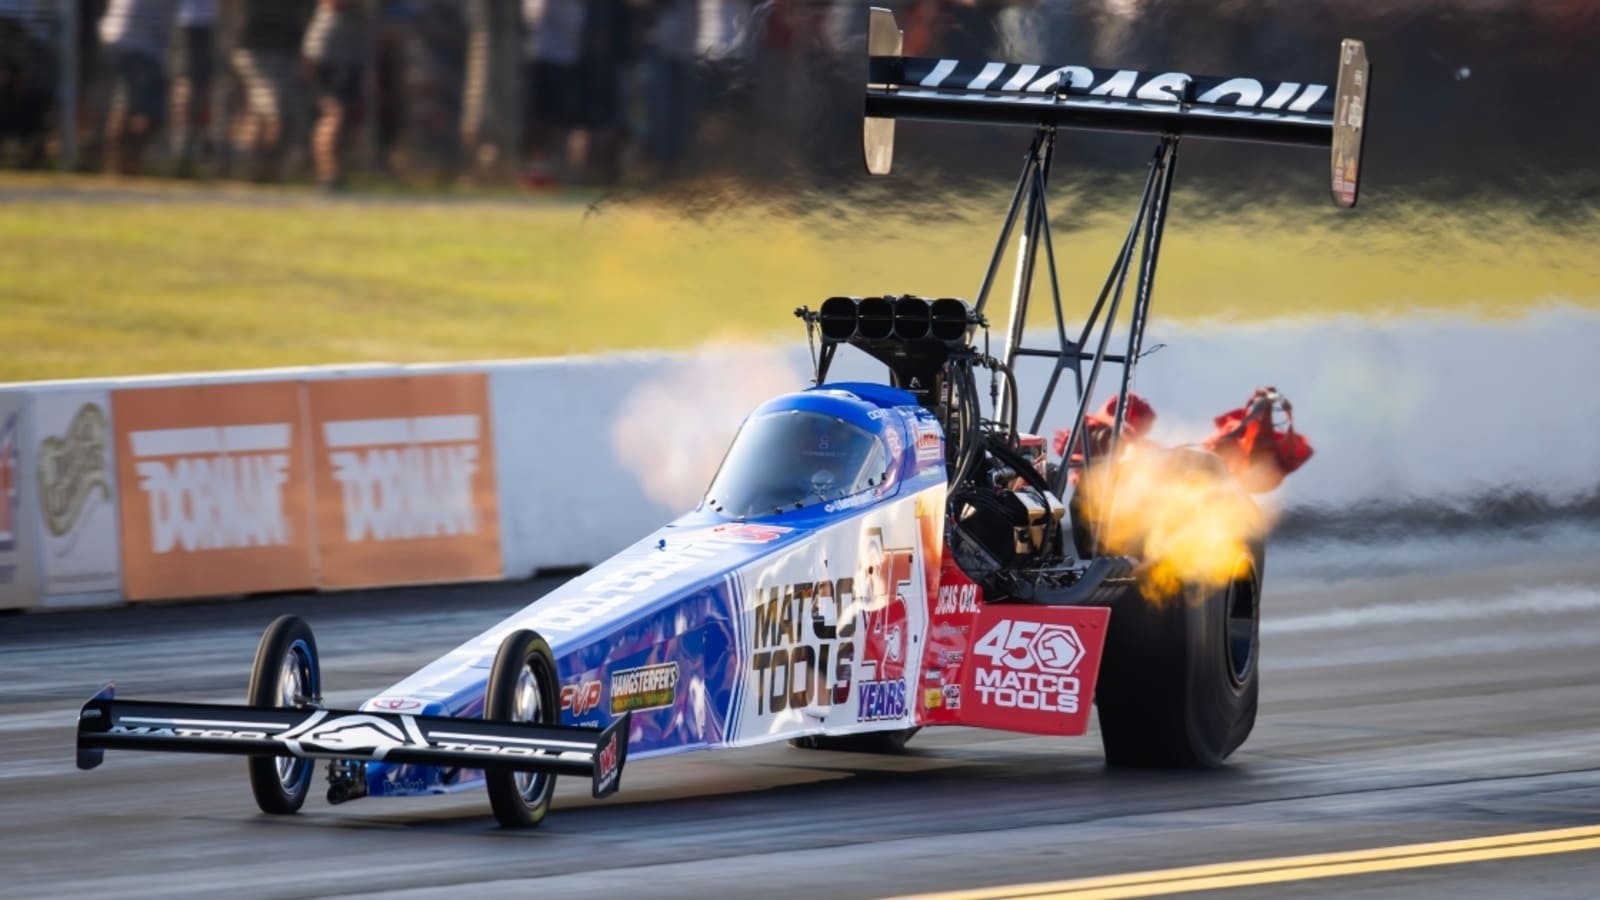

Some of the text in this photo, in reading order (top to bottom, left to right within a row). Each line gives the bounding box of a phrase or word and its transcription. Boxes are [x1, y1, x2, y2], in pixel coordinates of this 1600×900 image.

[754, 577, 857, 649] MATCO
[973, 619, 1041, 670] 45
[611, 665, 678, 698] HANGSTERFER'S
[752, 641, 855, 716] TOOLS
[975, 667, 1080, 695] MATCO
[559, 680, 602, 718] FVP
[857, 679, 907, 722] YEARS
[974, 685, 1080, 714] TOOLS
[107, 724, 270, 741] MATCO
[435, 741, 597, 762] TOOLS
